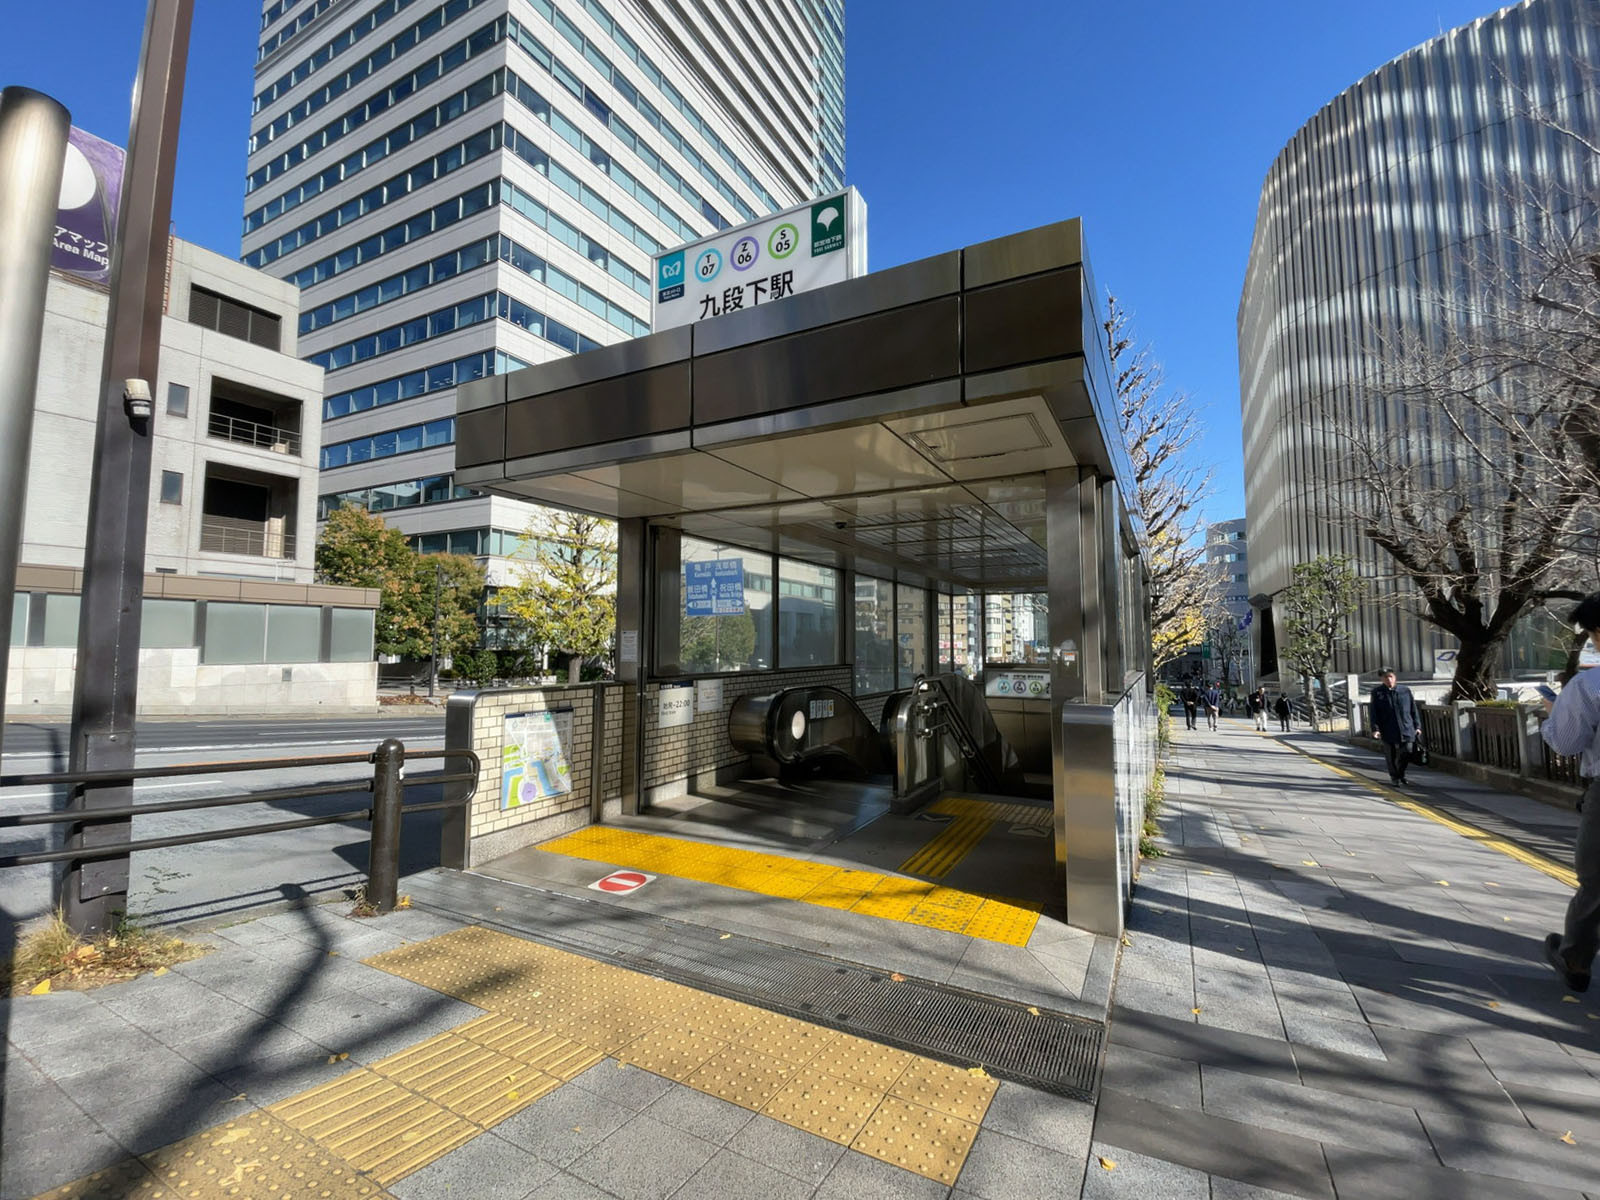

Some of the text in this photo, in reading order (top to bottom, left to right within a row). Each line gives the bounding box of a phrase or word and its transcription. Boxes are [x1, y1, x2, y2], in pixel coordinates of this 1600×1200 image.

[780, 229, 786, 239] S
[53, 237, 109, 265] Area Map
[741, 242, 749, 252] Z
[775, 239, 791, 253] 05
[706, 254, 712, 264] T
[738, 252, 752, 265] 06
[702, 264, 715, 276] 07
[700, 270, 794, 320] 九段下駅
